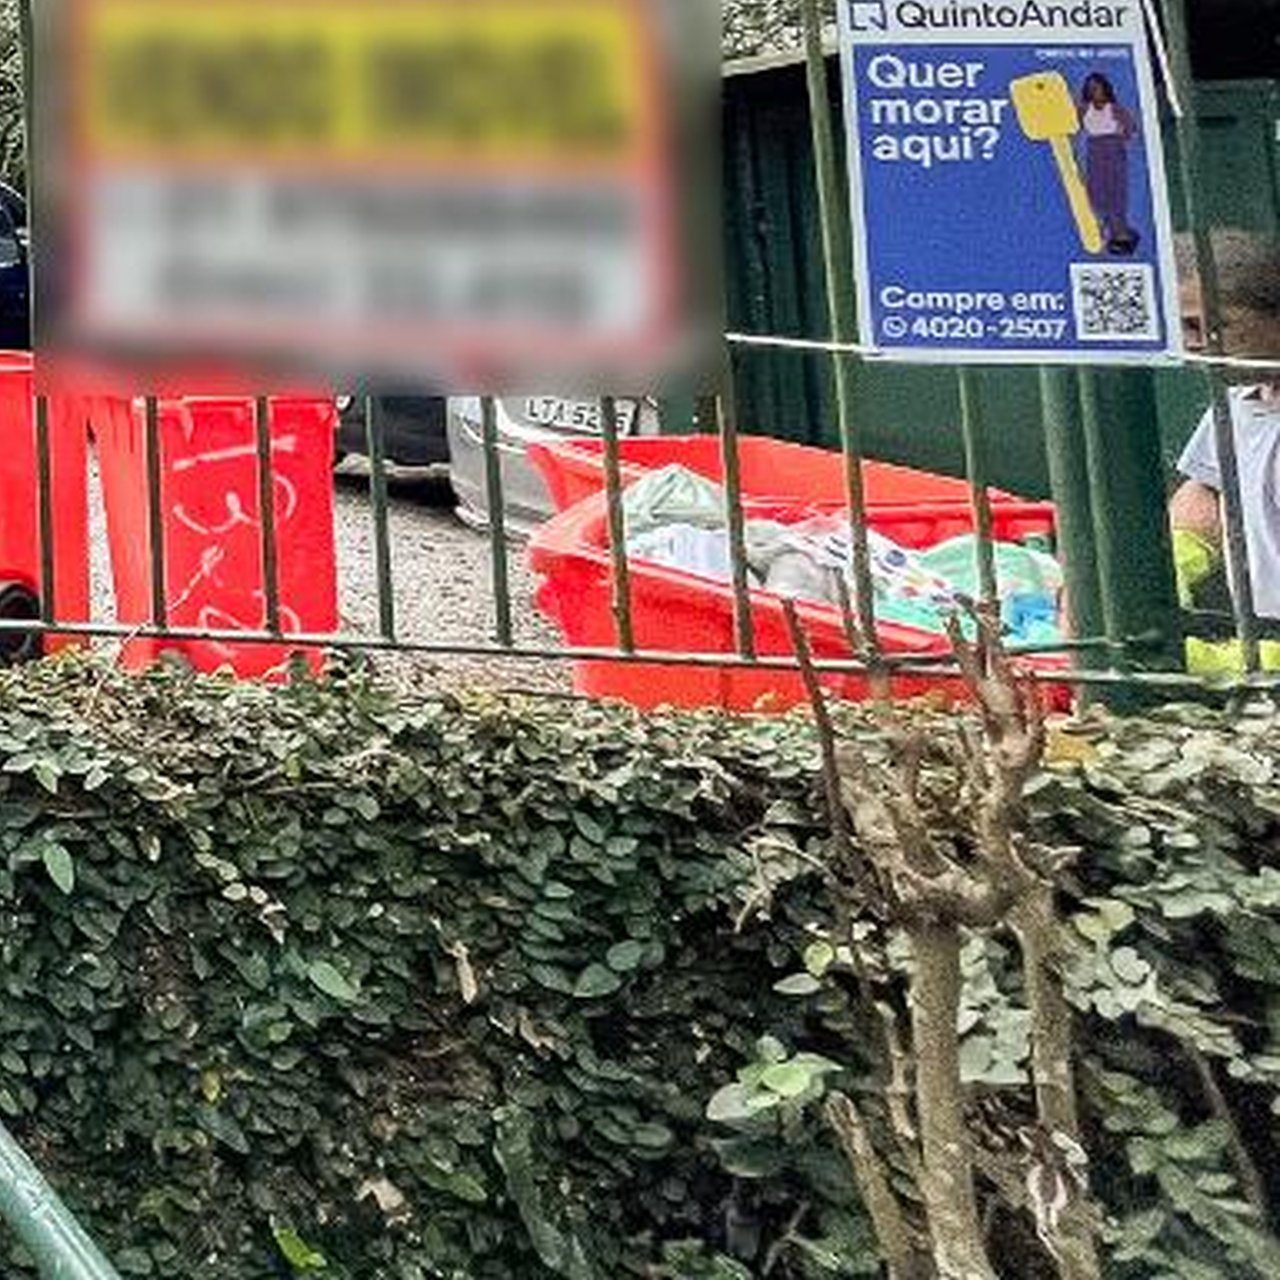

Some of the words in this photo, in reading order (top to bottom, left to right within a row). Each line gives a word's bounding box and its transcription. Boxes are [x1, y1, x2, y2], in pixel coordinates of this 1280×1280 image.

[895, 0, 1127, 28] QuintoAndar
[866, 54, 984, 88] Quer
[871, 98, 1008, 125] morar
[872, 126, 1000, 168] aqui?
[880, 285, 1005, 314] Compre
[1011, 292, 1065, 311] em:
[911, 316, 1067, 339] 4020-2507
